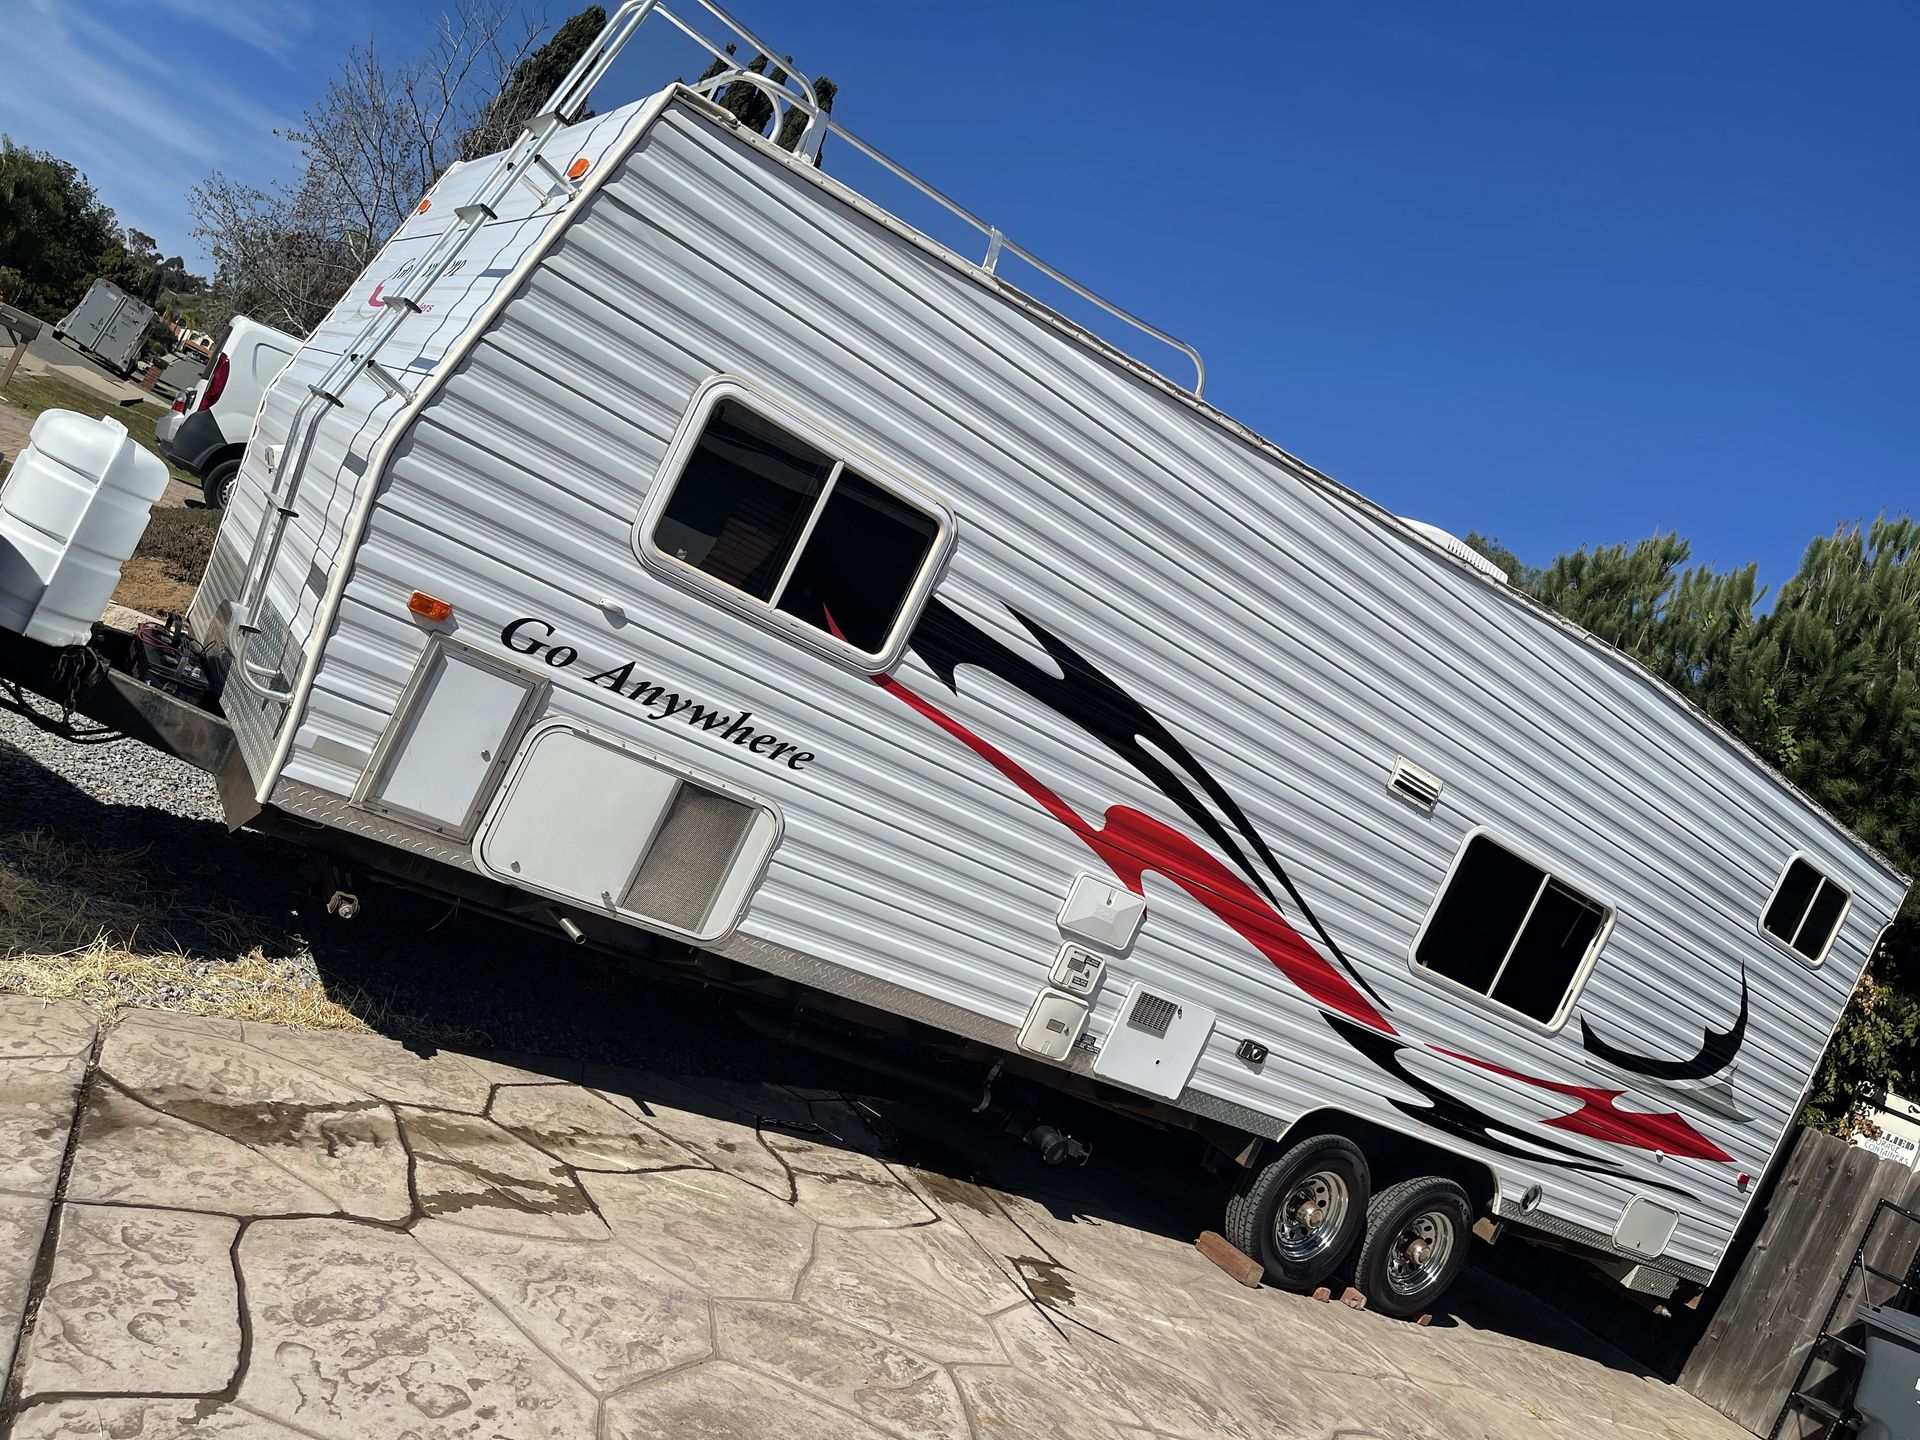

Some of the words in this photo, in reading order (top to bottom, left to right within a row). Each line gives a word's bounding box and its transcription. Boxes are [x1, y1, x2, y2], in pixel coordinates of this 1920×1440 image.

[500, 617, 578, 668] Go
[583, 661, 816, 770] Anywhere
[1880, 1130, 1915, 1151] LLIED
[1864, 1141, 1909, 1166] CONTAINERS
